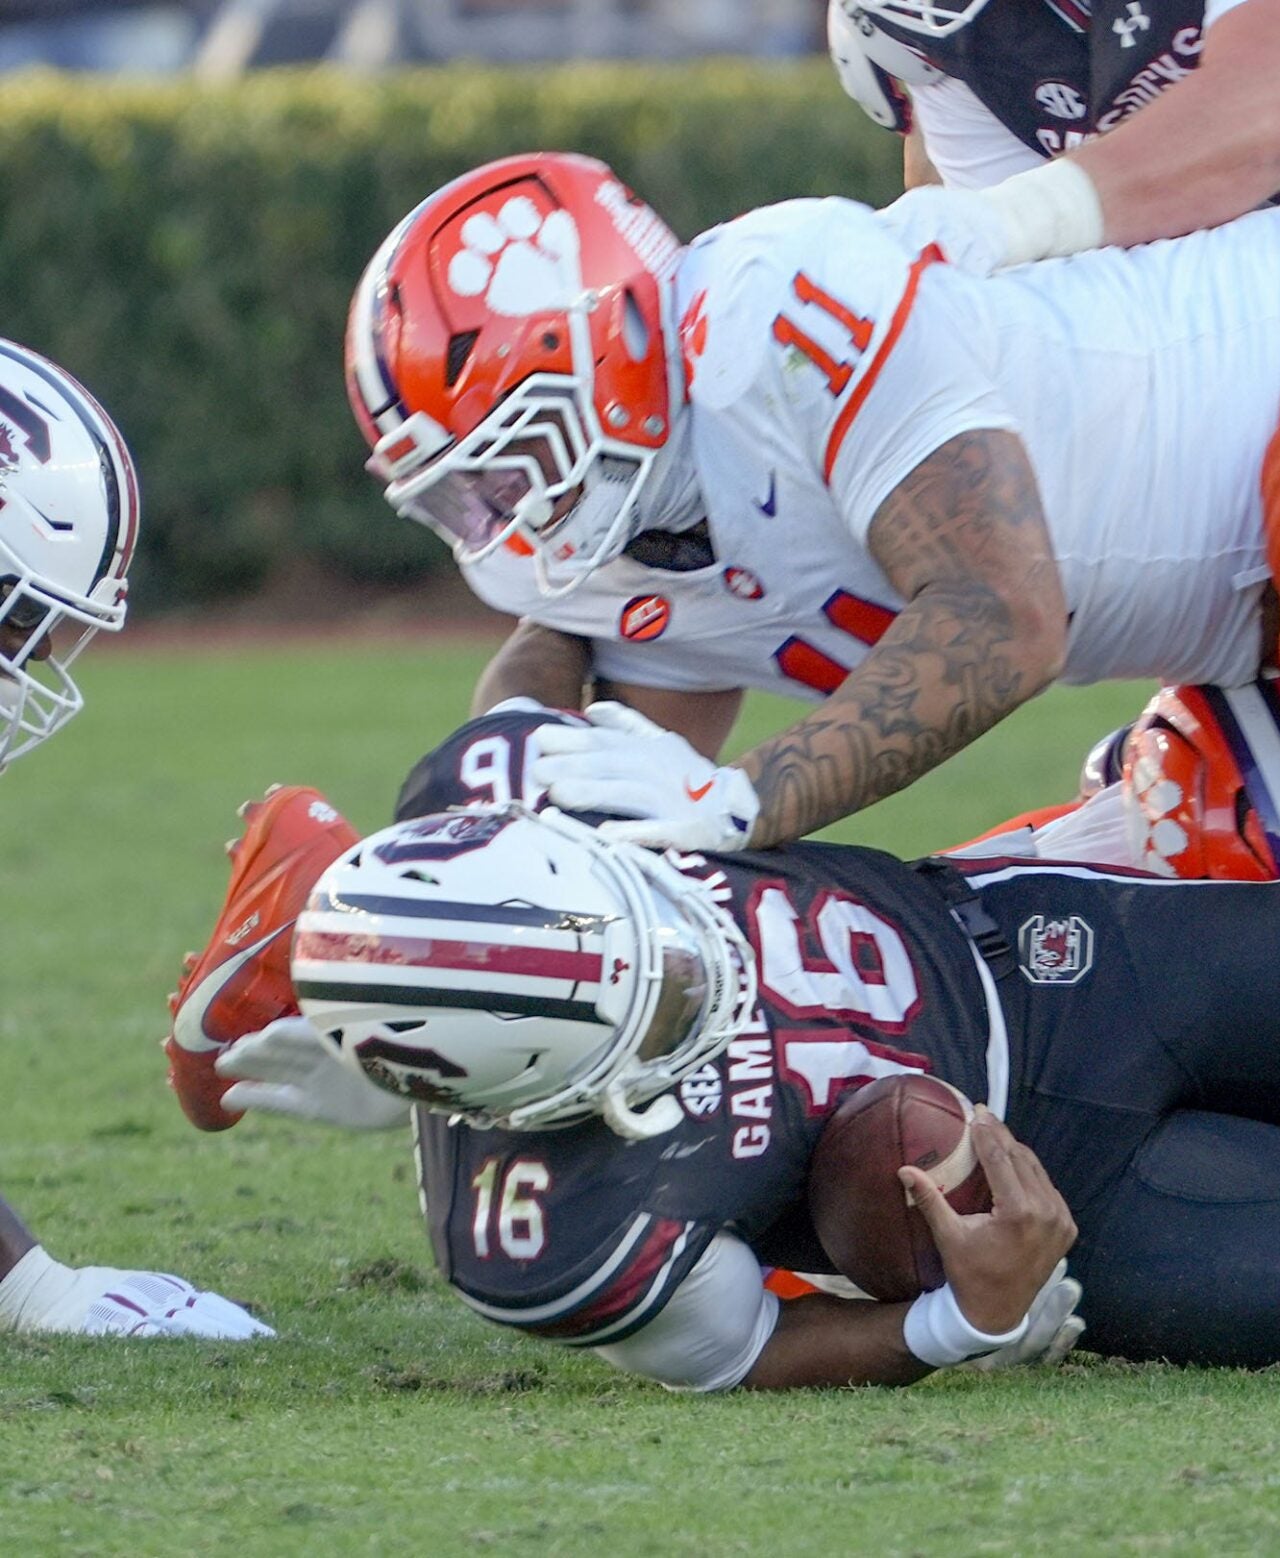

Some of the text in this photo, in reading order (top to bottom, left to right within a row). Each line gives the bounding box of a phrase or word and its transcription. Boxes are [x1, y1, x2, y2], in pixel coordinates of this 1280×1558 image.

[772, 271, 875, 397] 11
[754, 884, 926, 1112] 16
[471, 1158, 550, 1260] 16
